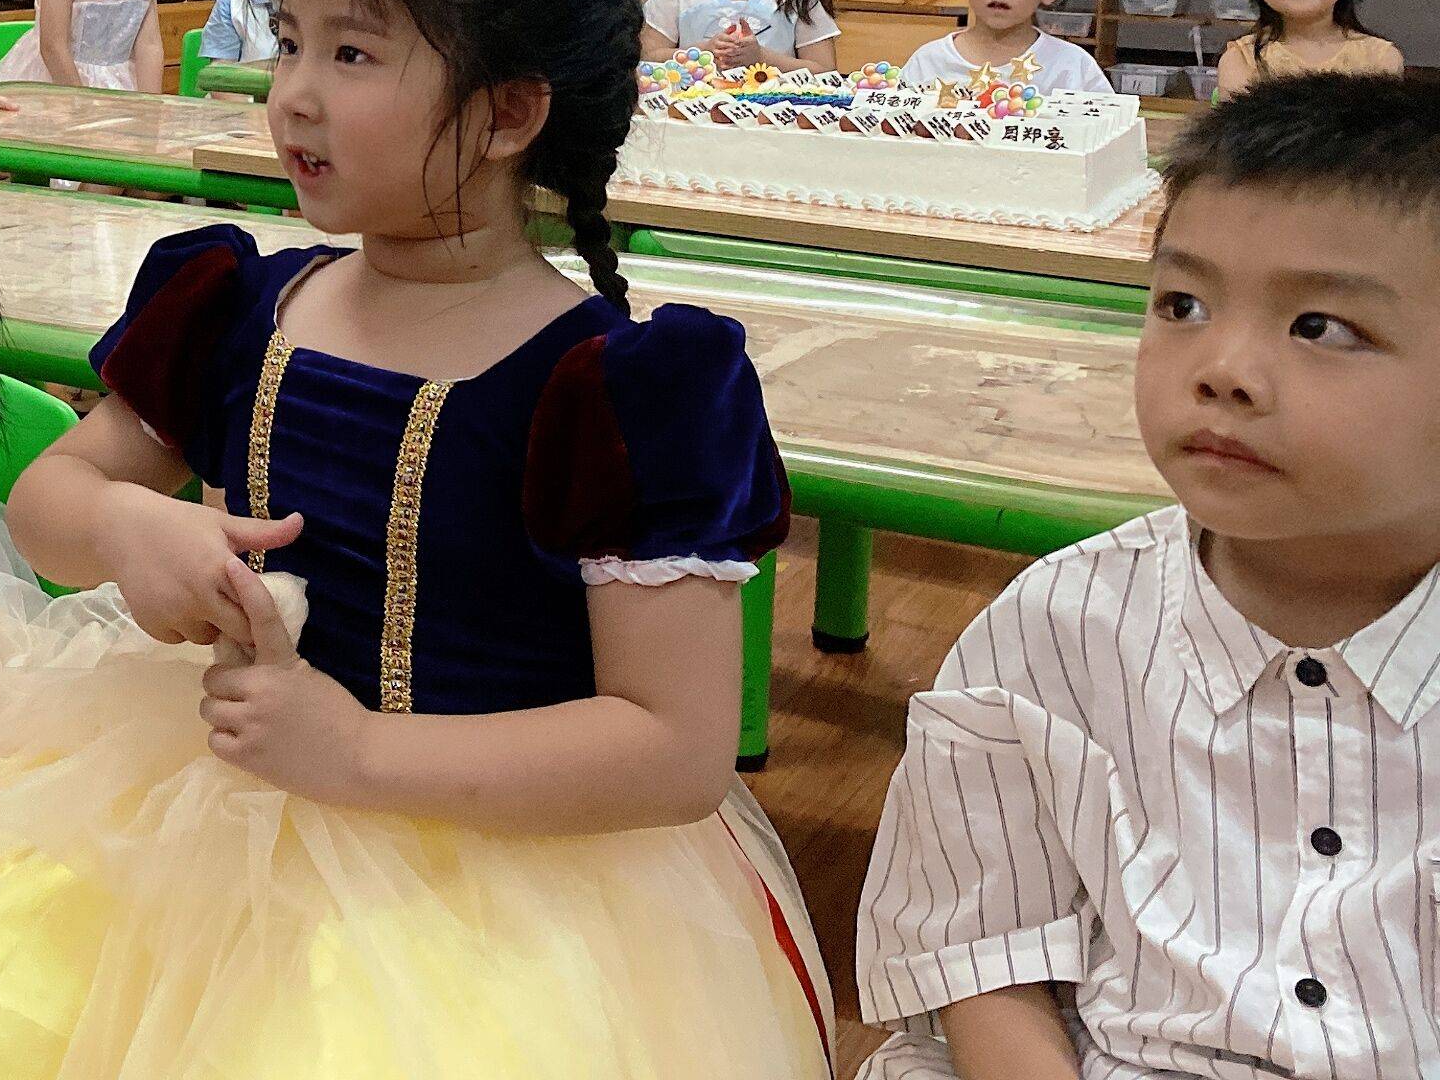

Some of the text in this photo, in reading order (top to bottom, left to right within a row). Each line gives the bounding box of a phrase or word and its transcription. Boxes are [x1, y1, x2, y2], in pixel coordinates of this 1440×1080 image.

[865, 91, 922, 110] 杨老师
[1001, 125, 1070, 151] 周郑豪
